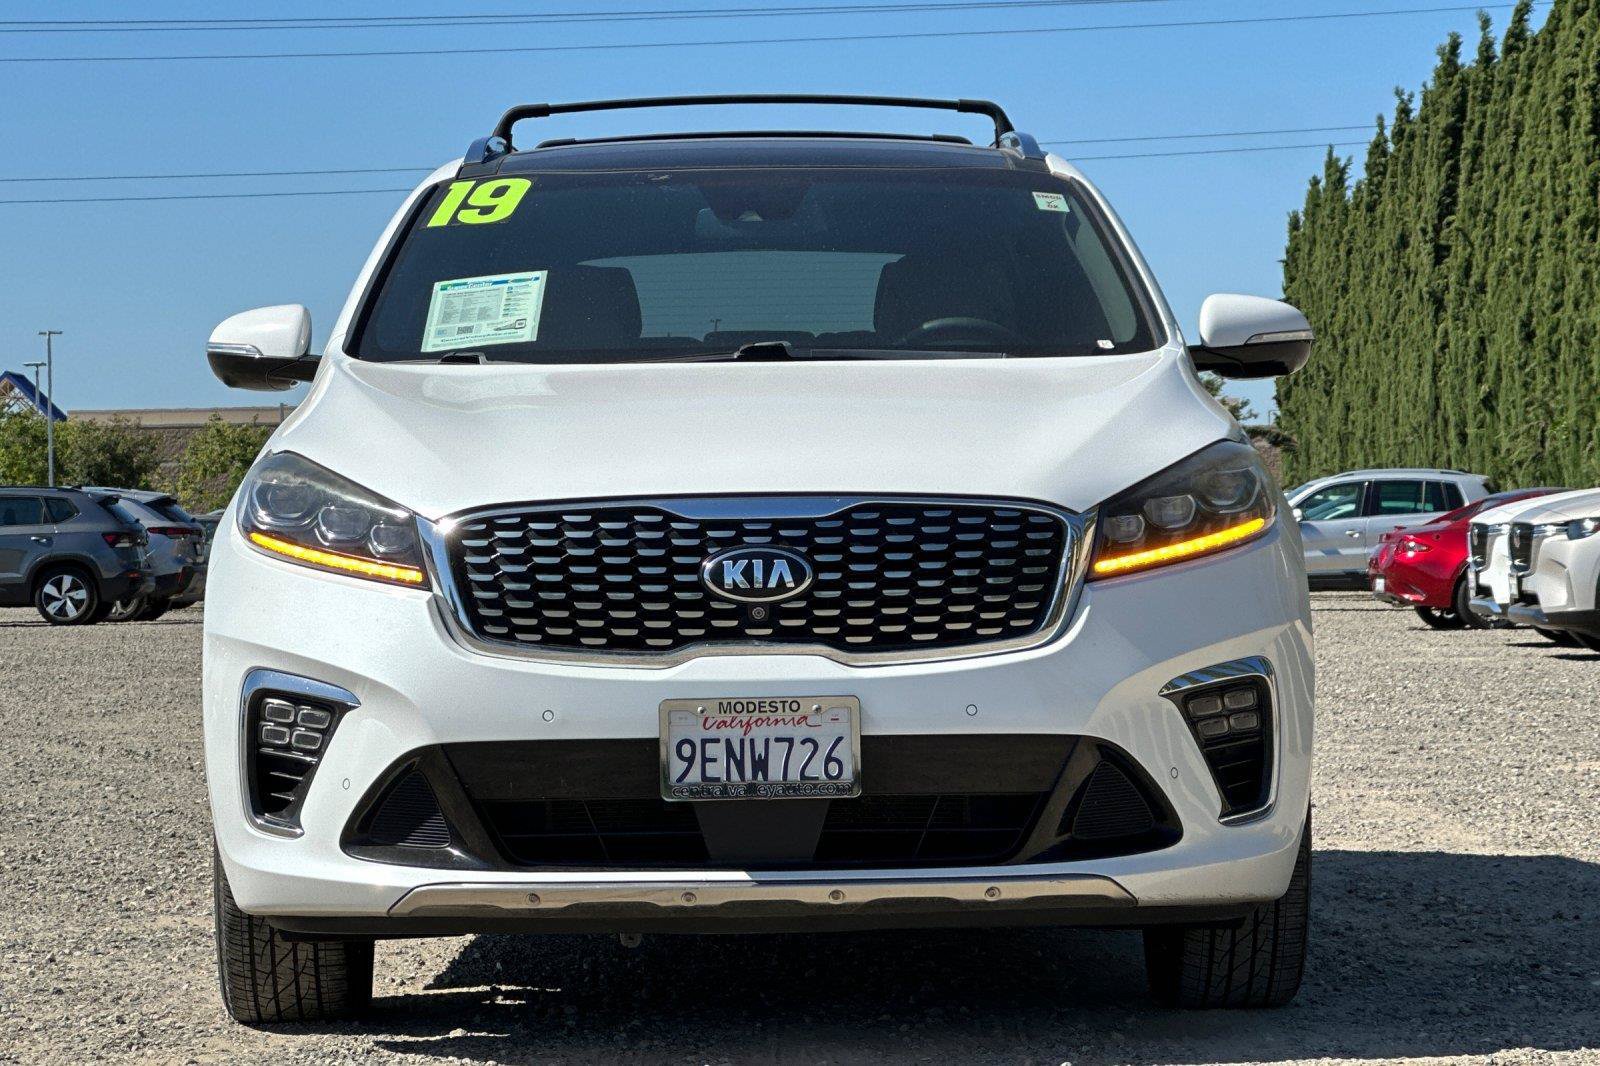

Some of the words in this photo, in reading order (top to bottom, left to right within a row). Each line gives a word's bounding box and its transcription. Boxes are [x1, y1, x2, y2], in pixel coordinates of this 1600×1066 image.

[427, 178, 532, 227] 19
[722, 559, 795, 589] KIA
[718, 699, 801, 715] MODESTO
[702, 715, 822, 736] California
[675, 735, 845, 784] 9ENW726
[672, 783, 852, 798] centravaeyauto.com
